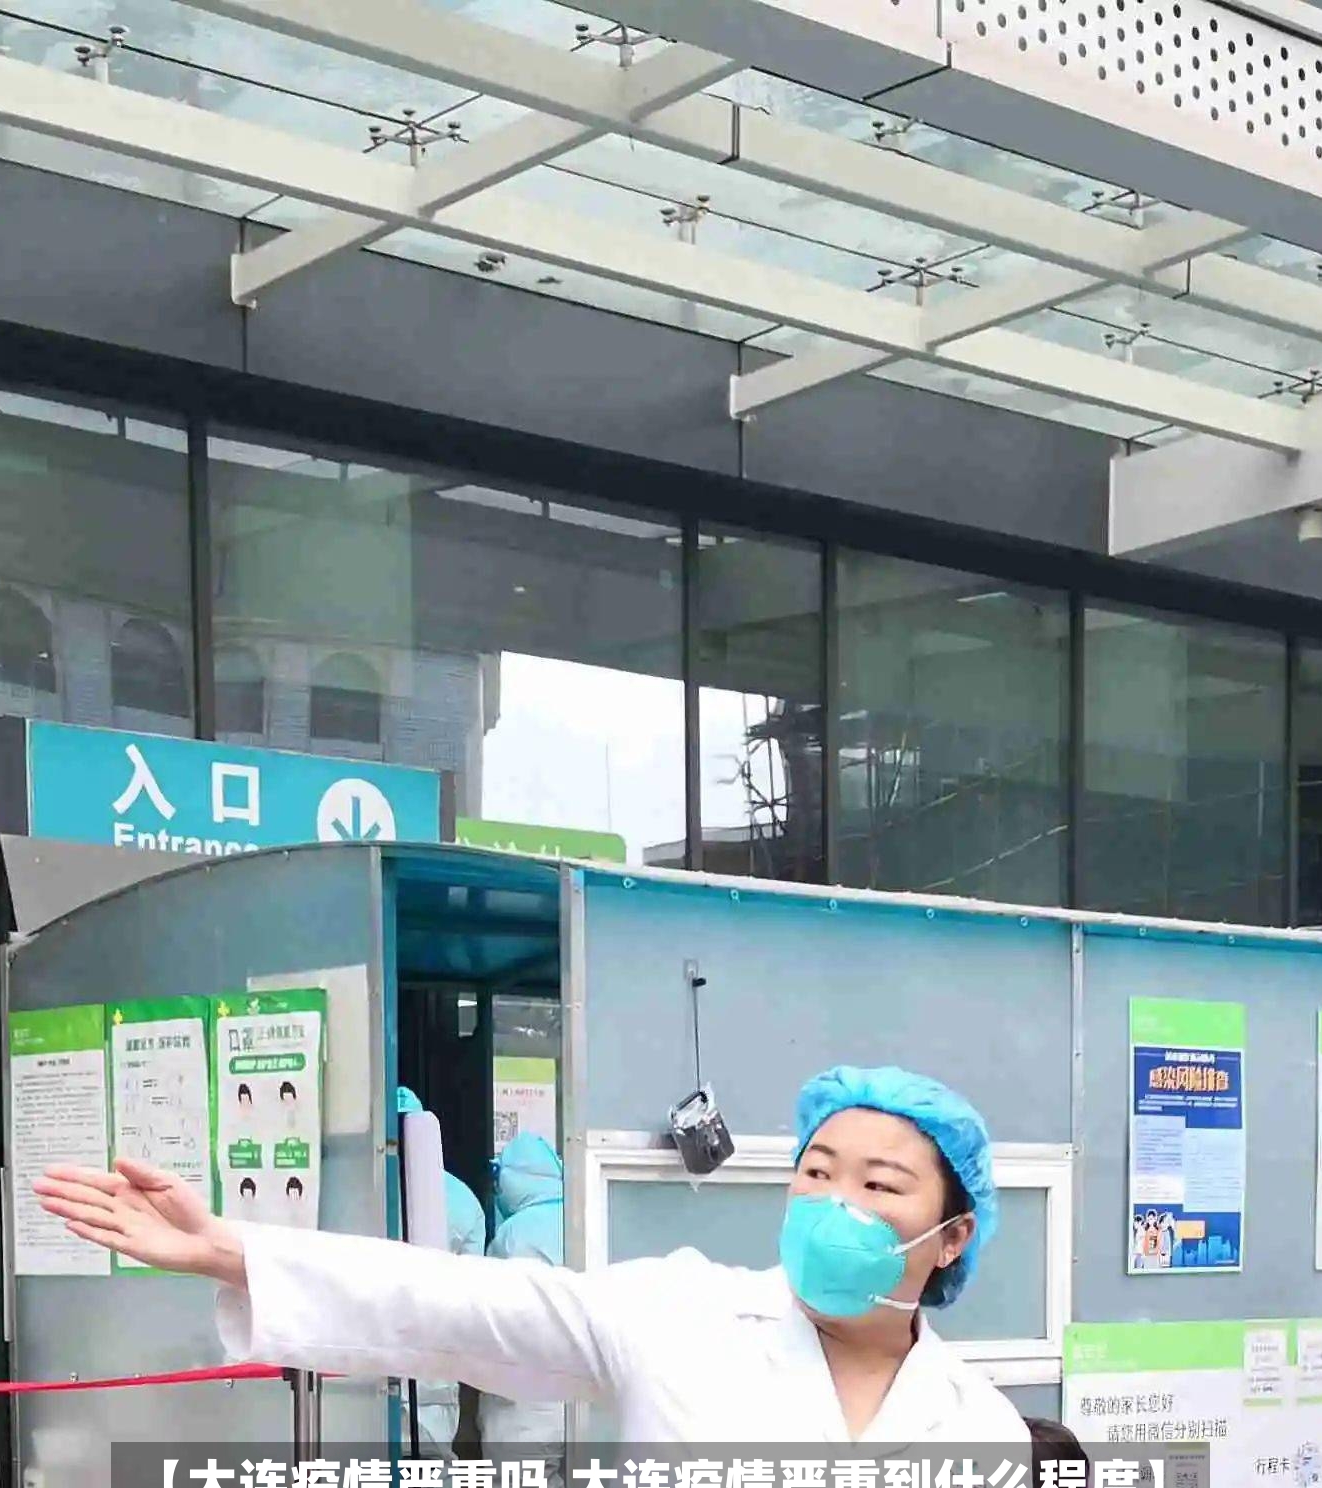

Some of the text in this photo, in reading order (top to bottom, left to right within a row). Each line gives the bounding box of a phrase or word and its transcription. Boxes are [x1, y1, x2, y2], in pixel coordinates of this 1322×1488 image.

[112, 743, 260, 826] 入口
[1080, 1393, 1174, 1416] 尊敬的家长您好
[1108, 1417, 1228, 1443] 请您用微信分别扫描
[1255, 1457, 1291, 1476] 行程卡
